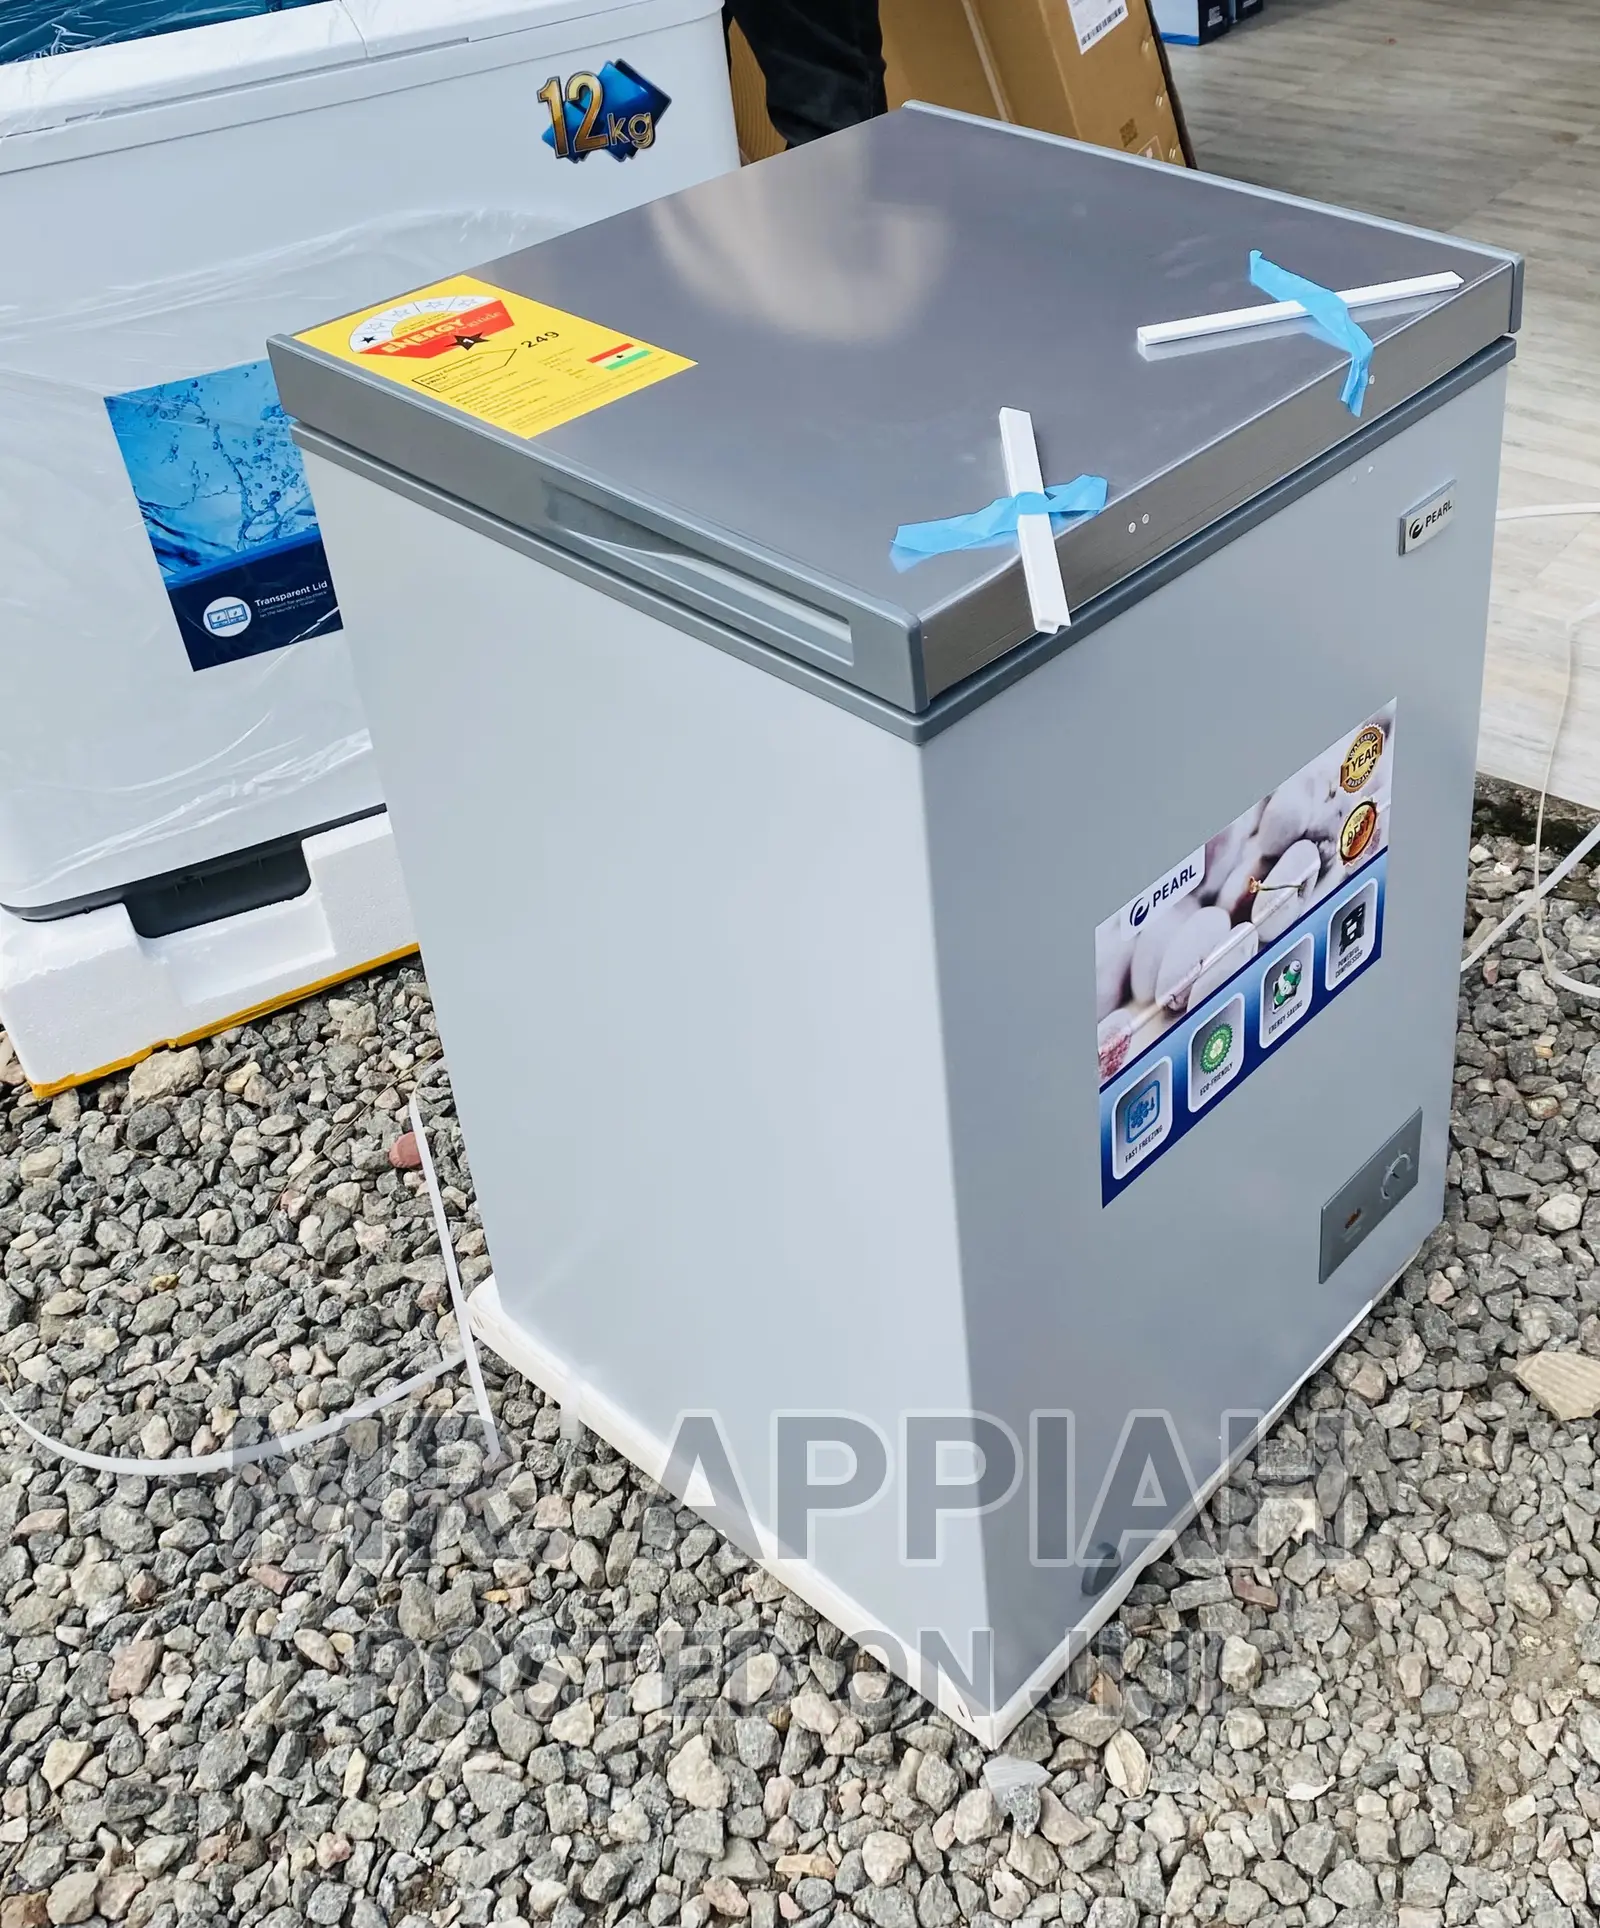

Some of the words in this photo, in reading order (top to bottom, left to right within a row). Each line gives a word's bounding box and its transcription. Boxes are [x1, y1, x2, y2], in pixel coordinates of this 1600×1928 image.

[381, 318, 465, 353] ENERGY
[520, 331, 560, 348] 249
[1425, 499, 1453, 528] PEARL
[254, 585, 312, 607] Transparent
[312, 580, 328, 592] Lid
[1351, 743, 1379, 772] YEAR
[1346, 810, 1371, 848] BEST
[1152, 864, 1197, 908] PEARL
[1199, 1061, 1234, 1096] ECO-FRIENDLY
[1124, 1146, 1138, 1163] FAST
[1138, 1124, 1163, 1150] FREEZING
